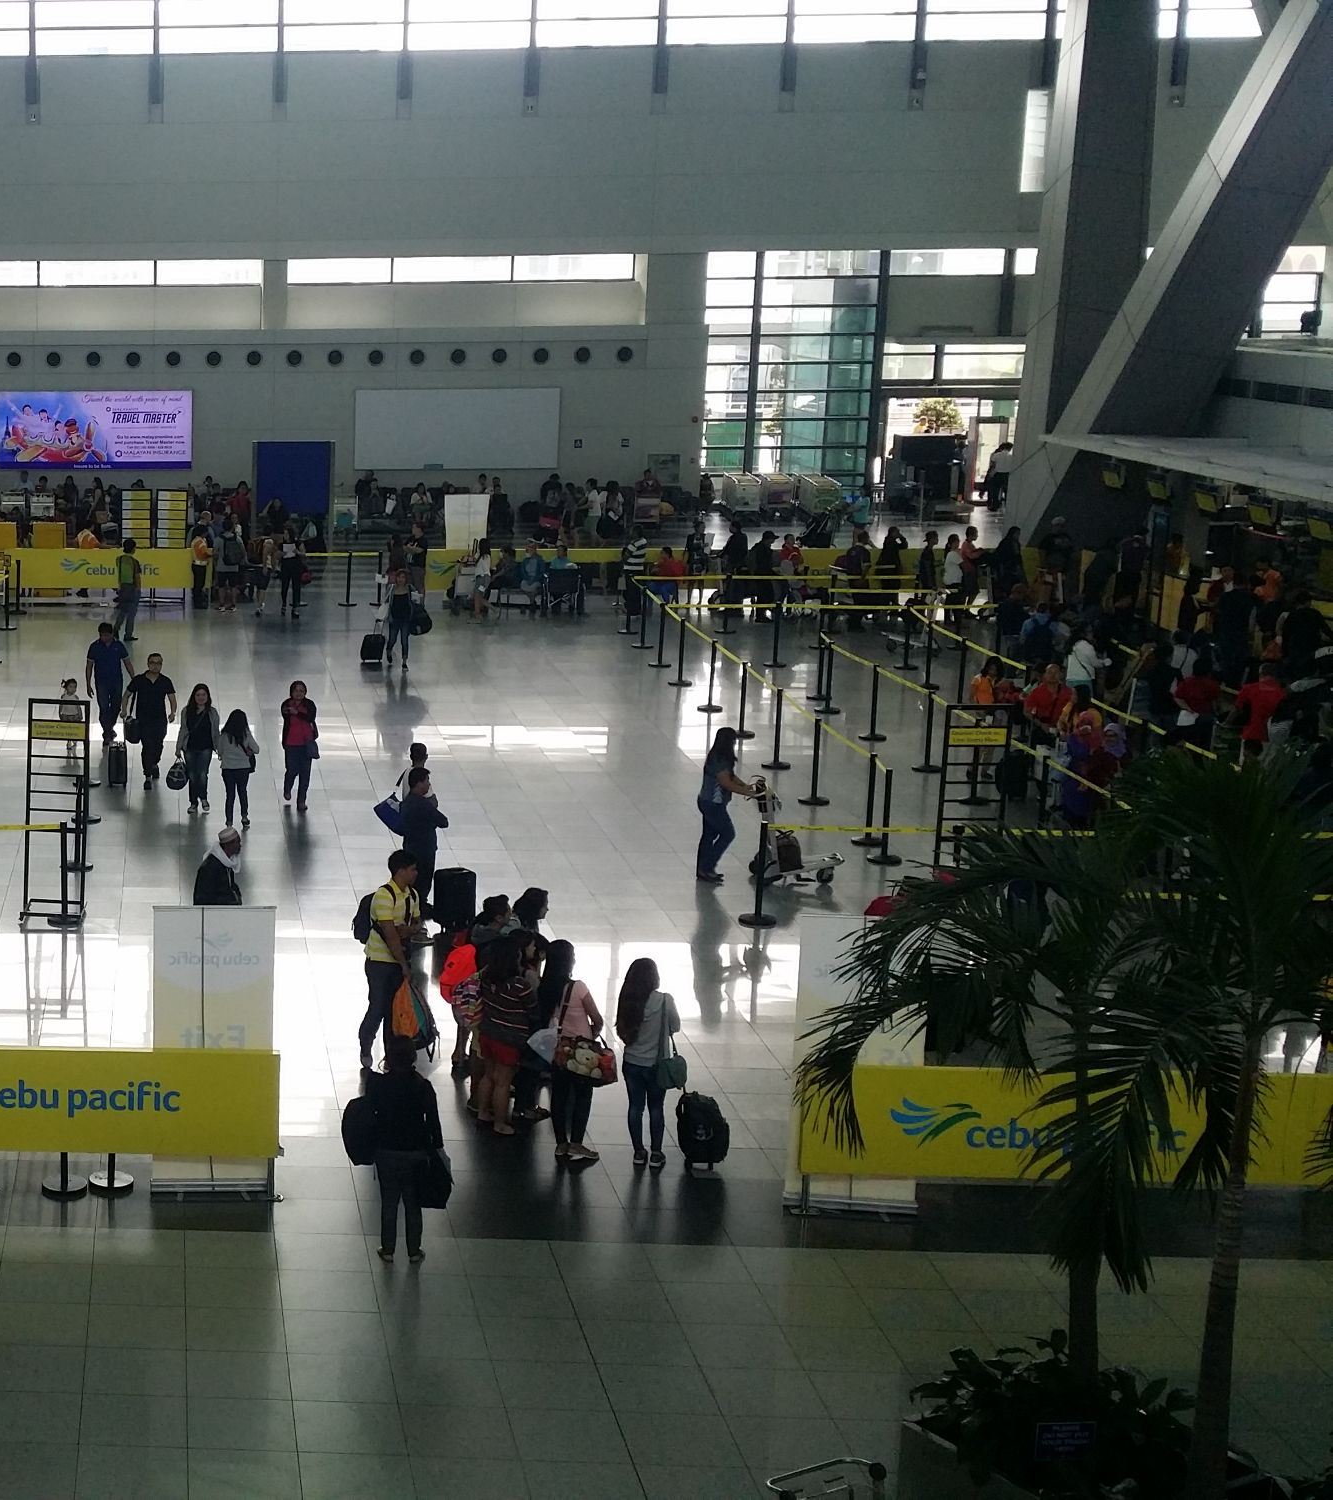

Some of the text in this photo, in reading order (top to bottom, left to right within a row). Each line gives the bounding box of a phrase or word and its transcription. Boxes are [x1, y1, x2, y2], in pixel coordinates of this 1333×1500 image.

[111, 411, 177, 424] TRAVEL MASTER
[85, 563, 116, 577] cebu
[67, 1080, 182, 1119] pacific
